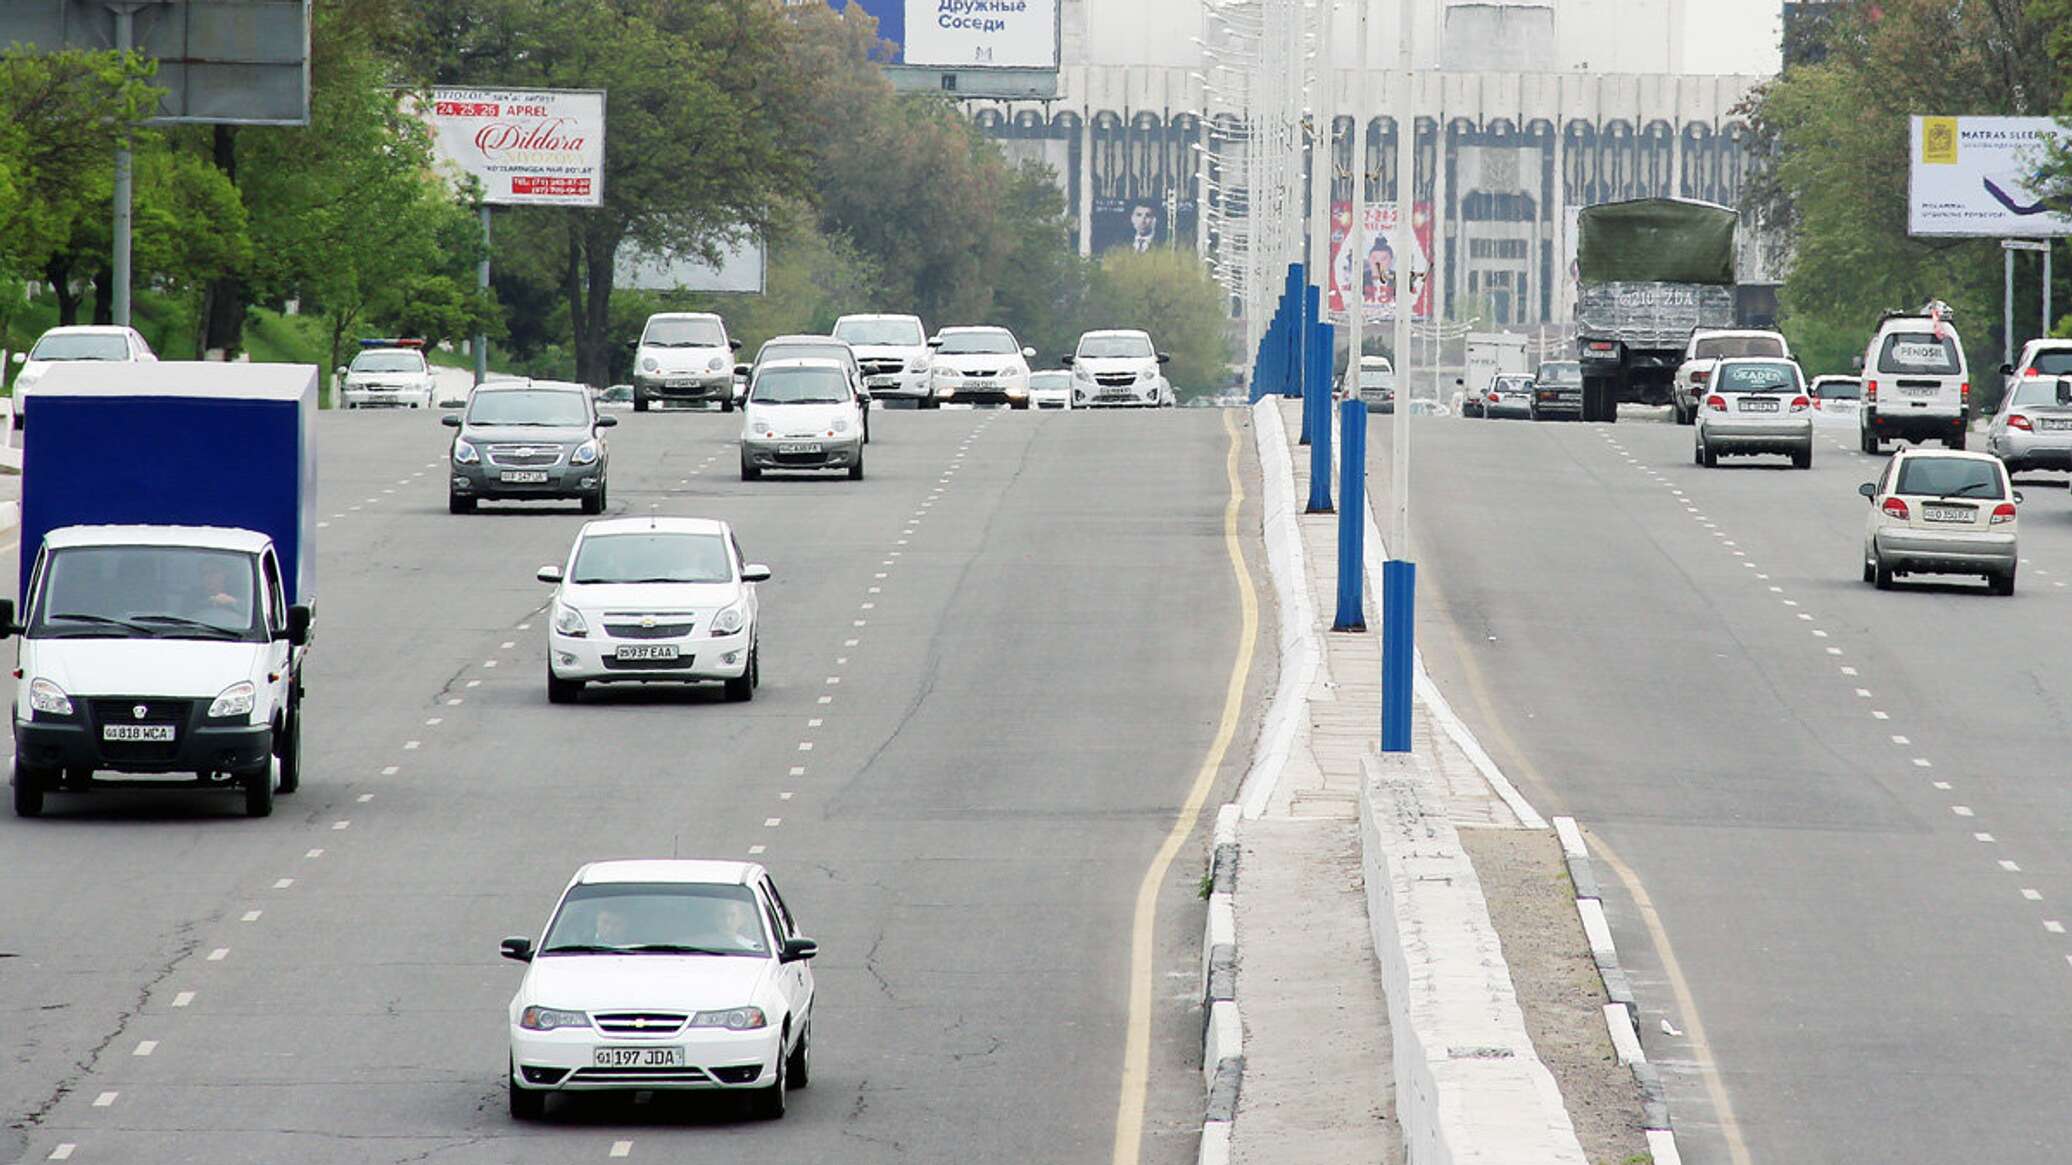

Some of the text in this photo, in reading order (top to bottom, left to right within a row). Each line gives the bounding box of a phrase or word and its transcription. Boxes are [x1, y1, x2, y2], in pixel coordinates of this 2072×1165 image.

[938, 0, 1027, 15] Дружные
[938, 14, 1005, 32] Соседи
[506, 105, 548, 117] APREL
[475, 117, 585, 160] Dildora
[1961, 131, 2007, 140] MATRAS
[1663, 291, 1693, 306] ZDA
[650, 647, 672, 657] EAA
[118, 727, 140, 739] 818
[596, 1051, 675, 1065] 01 197 JDA
